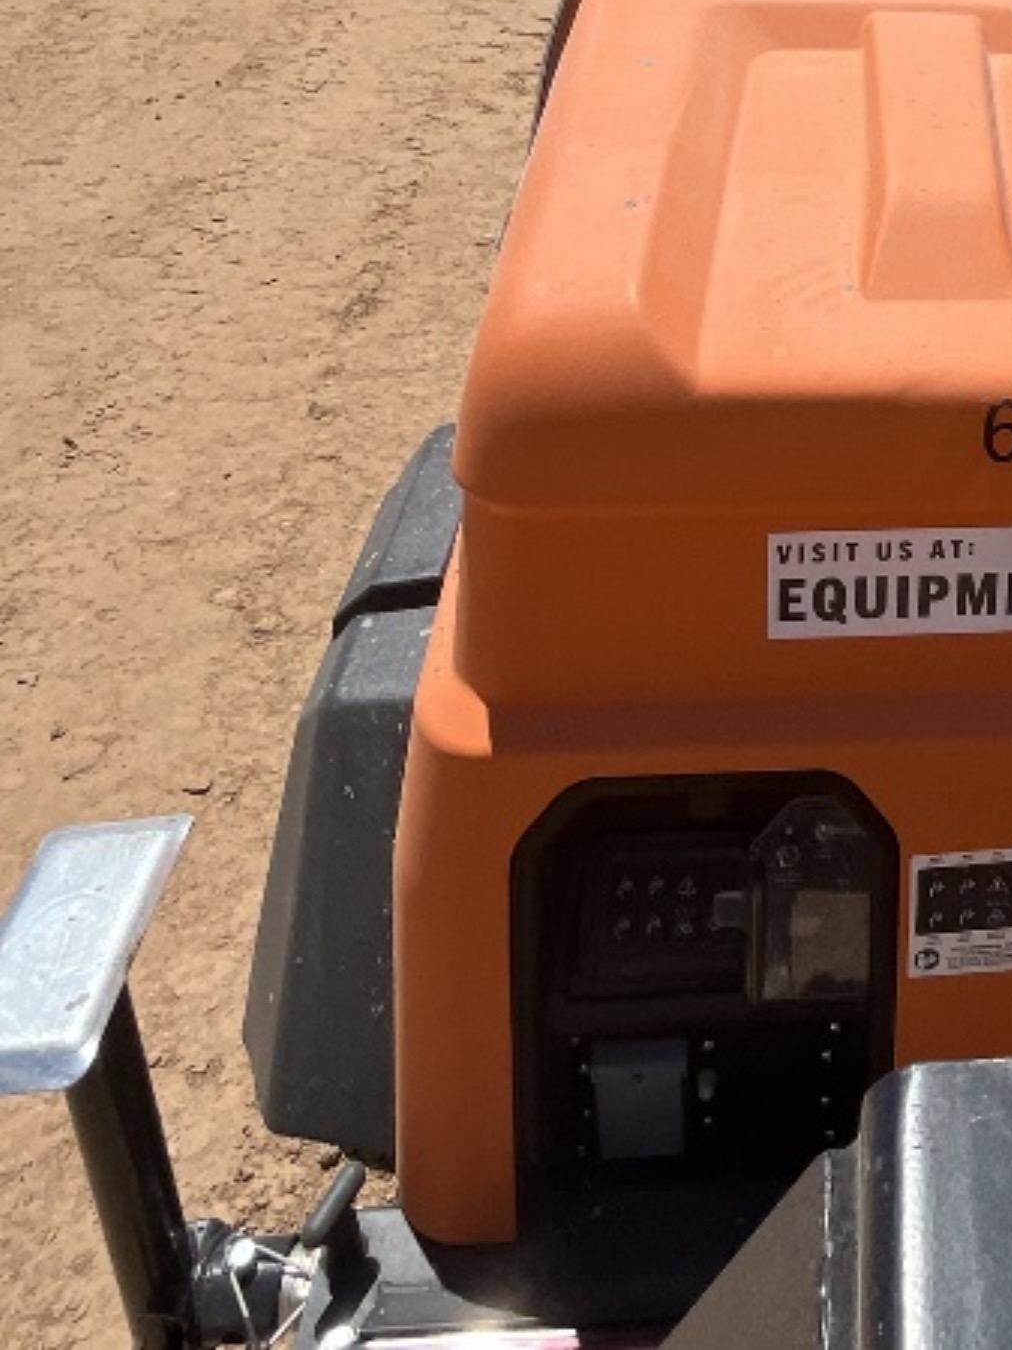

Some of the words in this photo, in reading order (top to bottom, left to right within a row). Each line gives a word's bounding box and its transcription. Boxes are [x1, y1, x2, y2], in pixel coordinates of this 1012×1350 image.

[776, 542, 859, 564] VISIT
[876, 541, 913, 562] US
[929, 539, 976, 560] AT:
